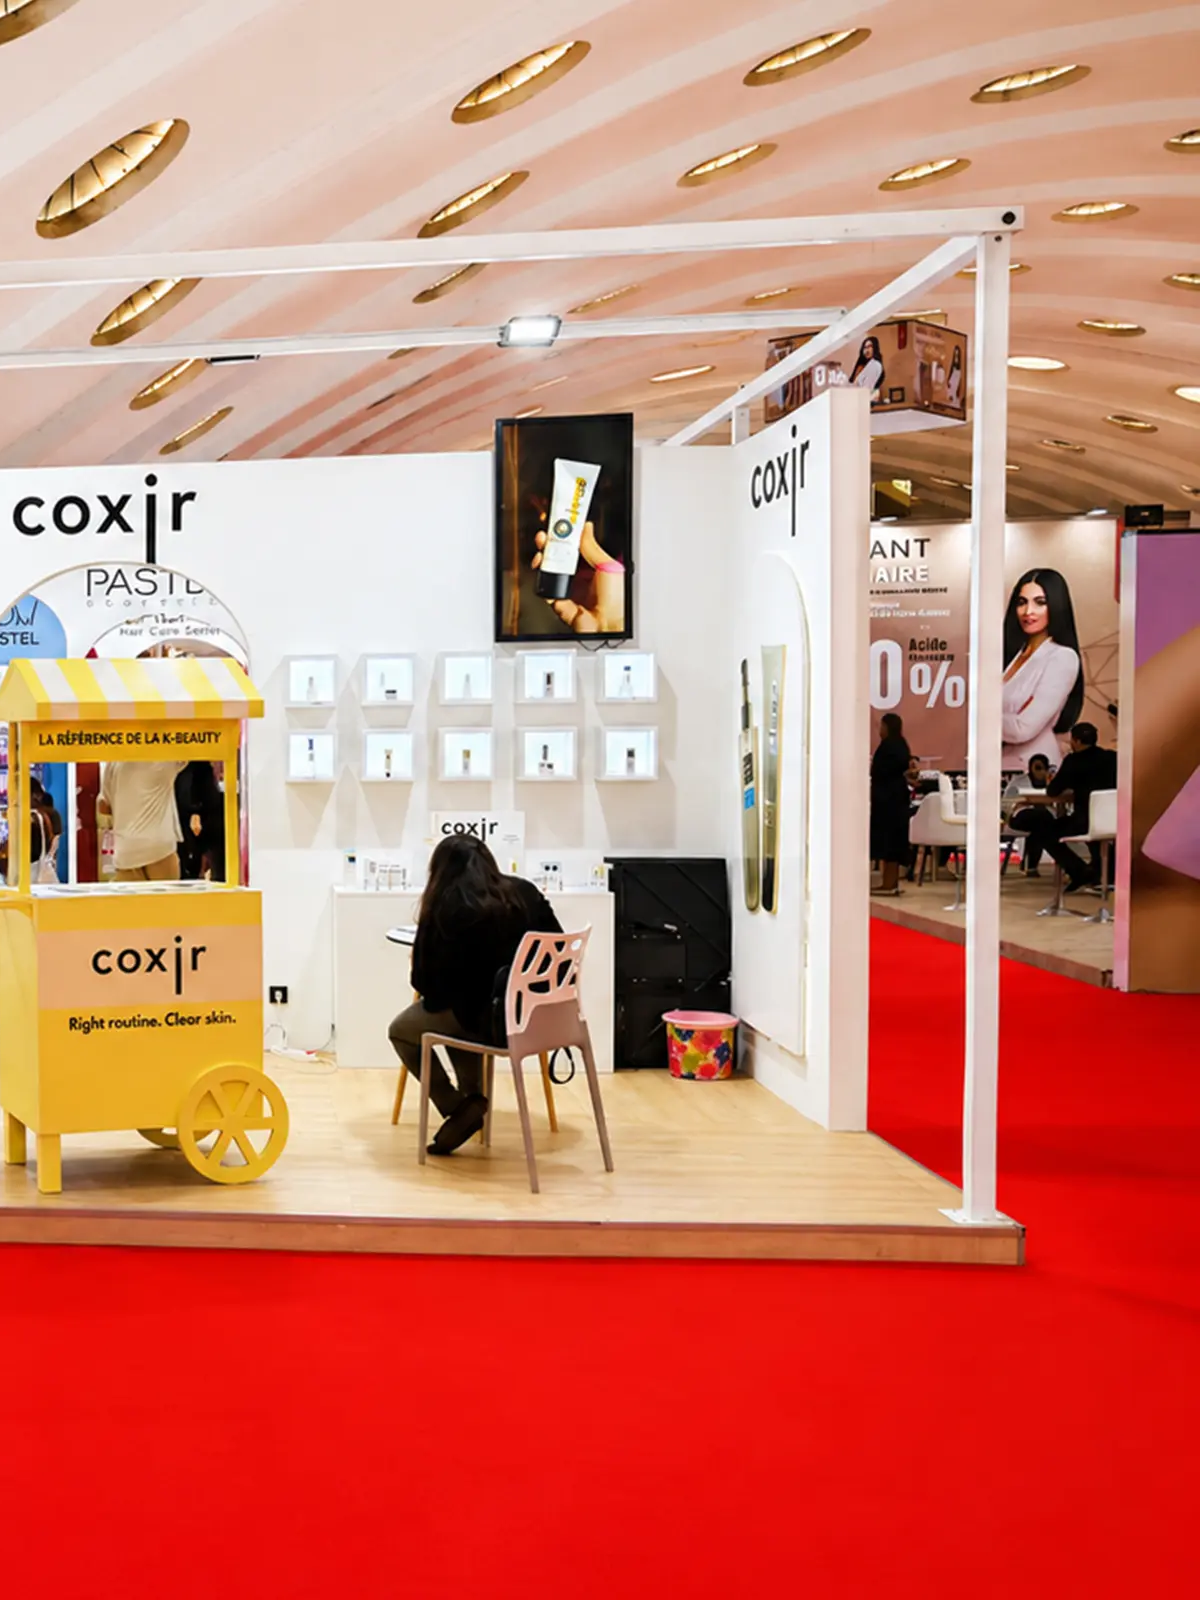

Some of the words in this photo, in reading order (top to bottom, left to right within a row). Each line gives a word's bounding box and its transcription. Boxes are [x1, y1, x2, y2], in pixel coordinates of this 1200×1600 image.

[870, 537, 932, 560] ANT
[870, 564, 930, 584] AIRE
[38, 733, 55, 747] LA
[56, 729, 123, 746] RÉFÉRENCE
[126, 731, 142, 745] DE
[144, 731, 160, 745] LA
[162, 730, 222, 745] K-BEAUTY
[69, 1015, 106, 1035] Right
[107, 1013, 163, 1030] routine.
[164, 1011, 202, 1027] Clear
[204, 1010, 238, 1025] skin.
